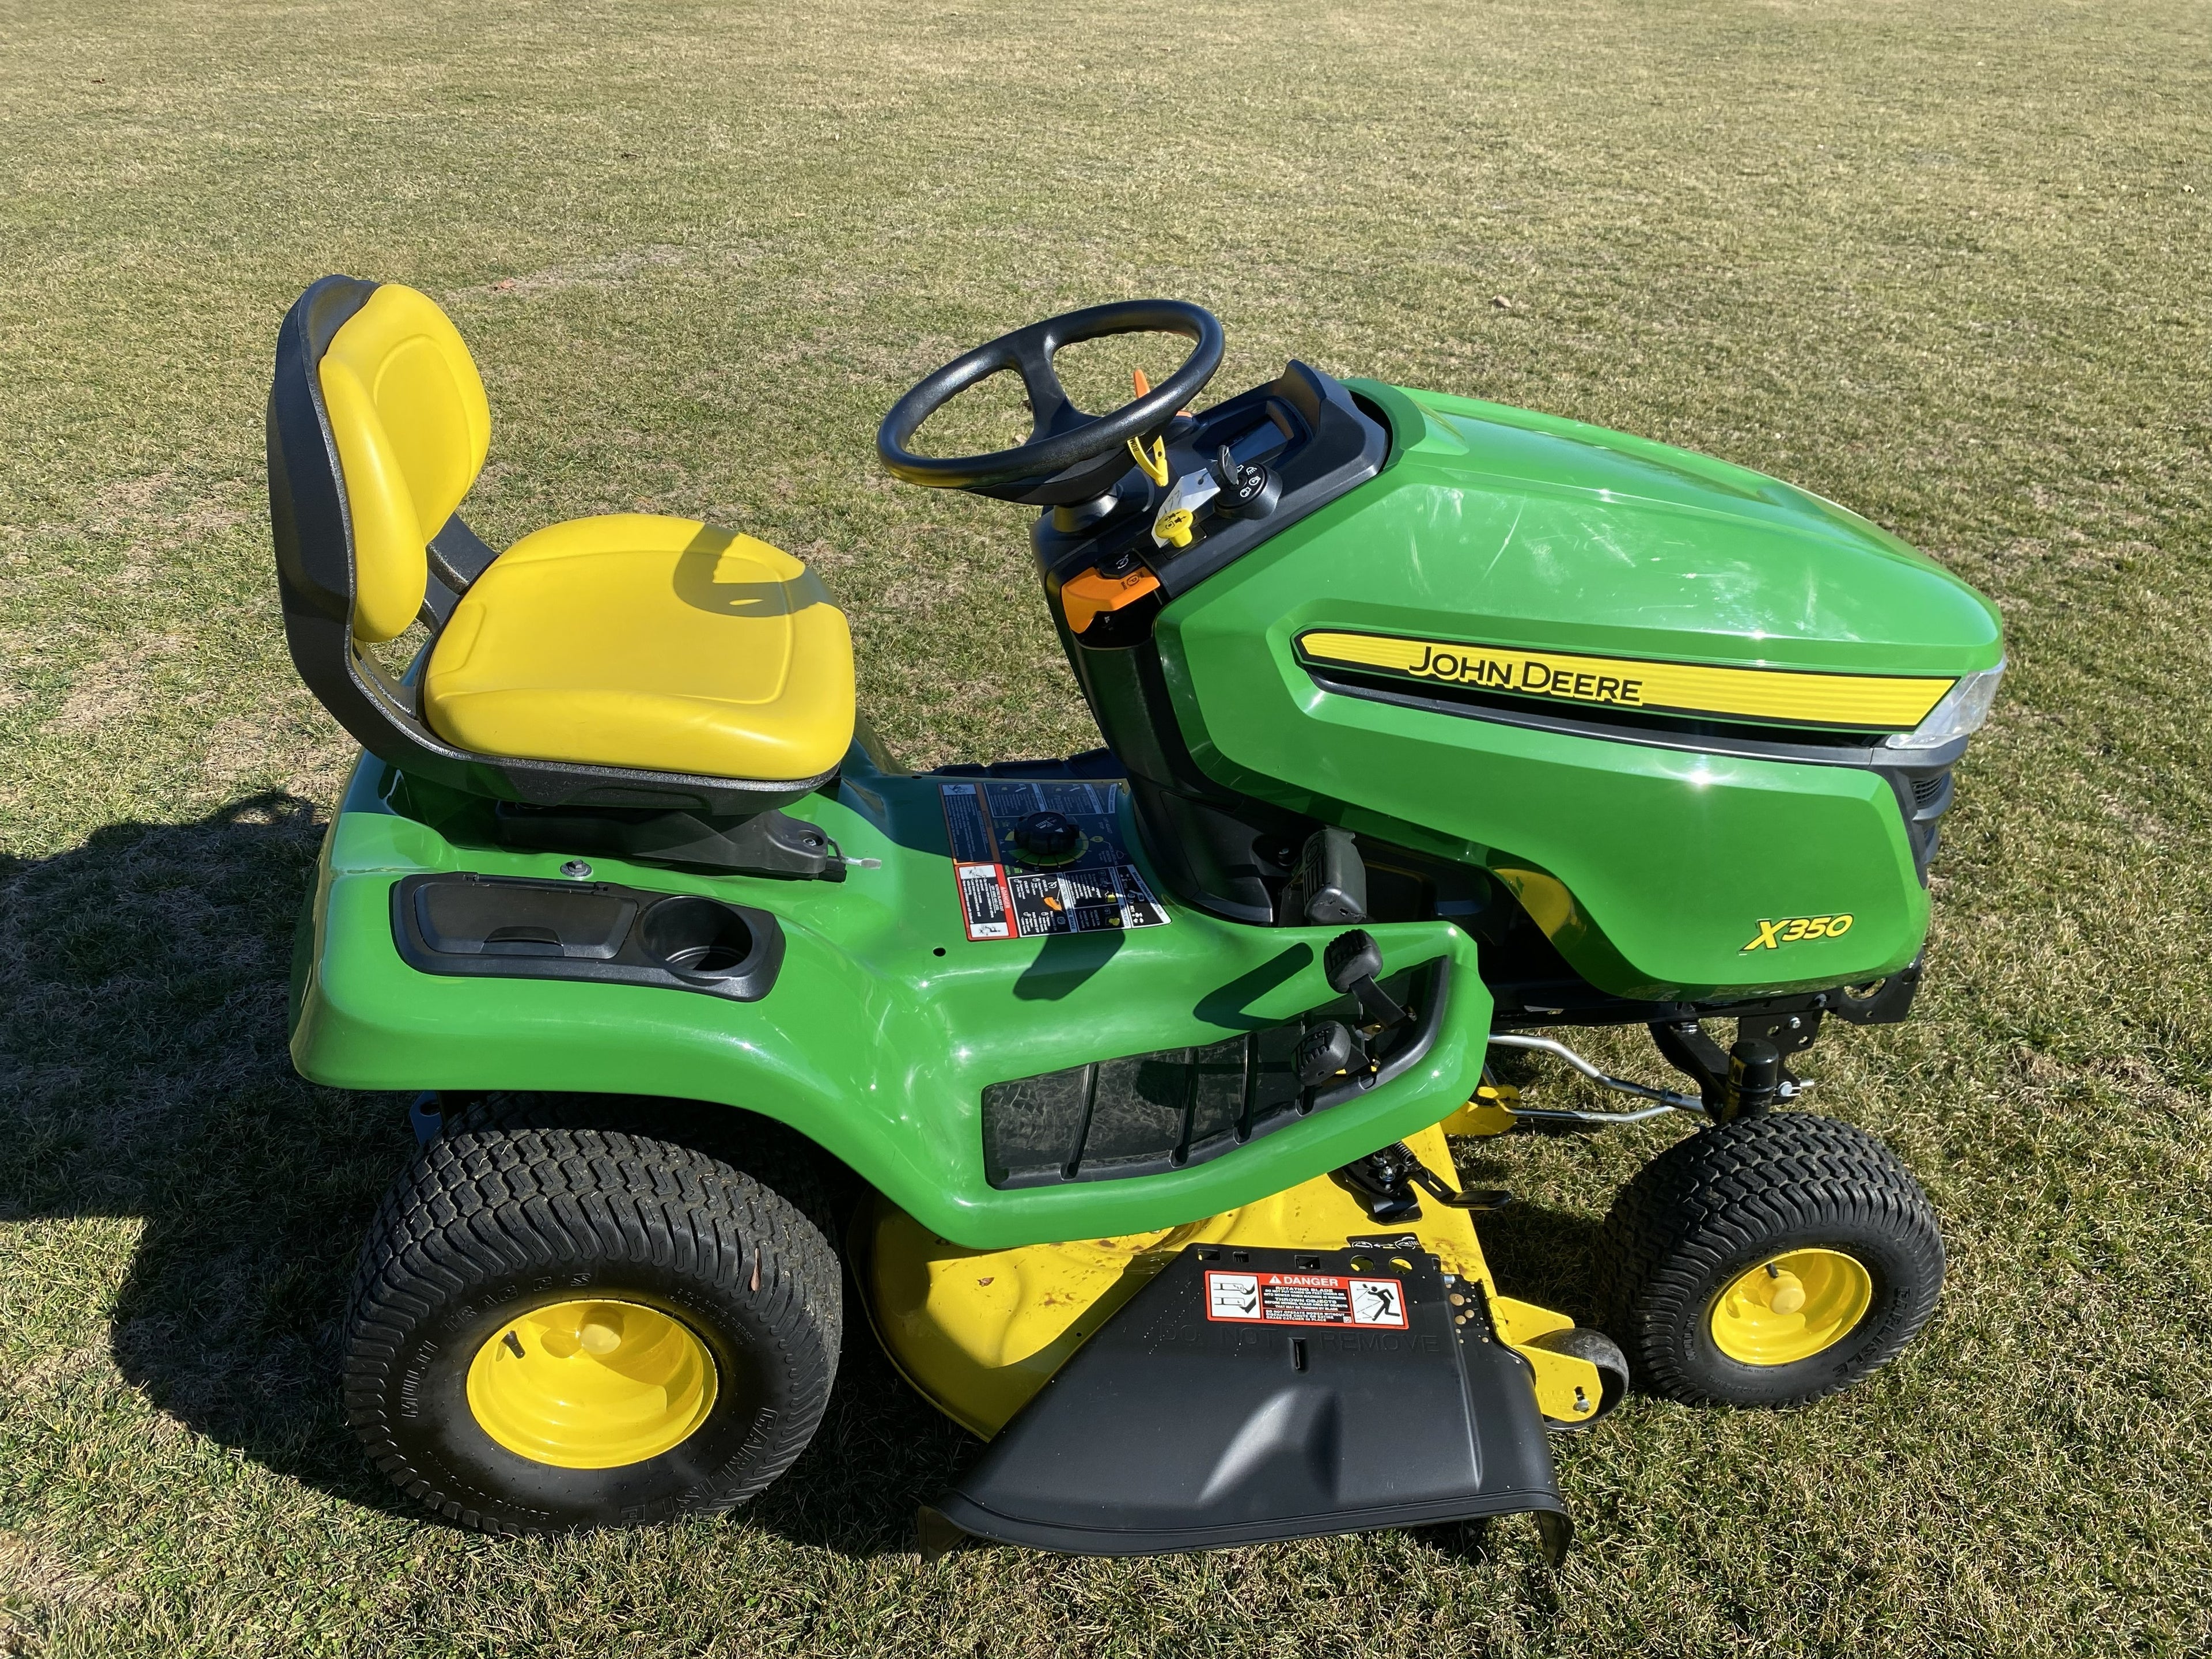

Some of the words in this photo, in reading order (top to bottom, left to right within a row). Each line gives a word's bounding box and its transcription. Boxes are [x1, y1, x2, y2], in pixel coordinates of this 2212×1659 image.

[1408, 645, 1514, 687] JOHN
[1521, 661, 1643, 704] DEERE
[1001, 890, 1010, 908] DANGER
[1737, 914, 1854, 952] X350
[1283, 1276, 1338, 1286] DANGER
[401, 1339, 438, 1418] MULTI
[442, 1284, 518, 1333] TRAC
[1219, 1326, 1279, 1348] NOT
[1319, 1330, 1441, 1354] REMOVE
[1832, 1286, 1910, 1378] CARLISLE
[619, 1406, 778, 1525] CARLISLE
